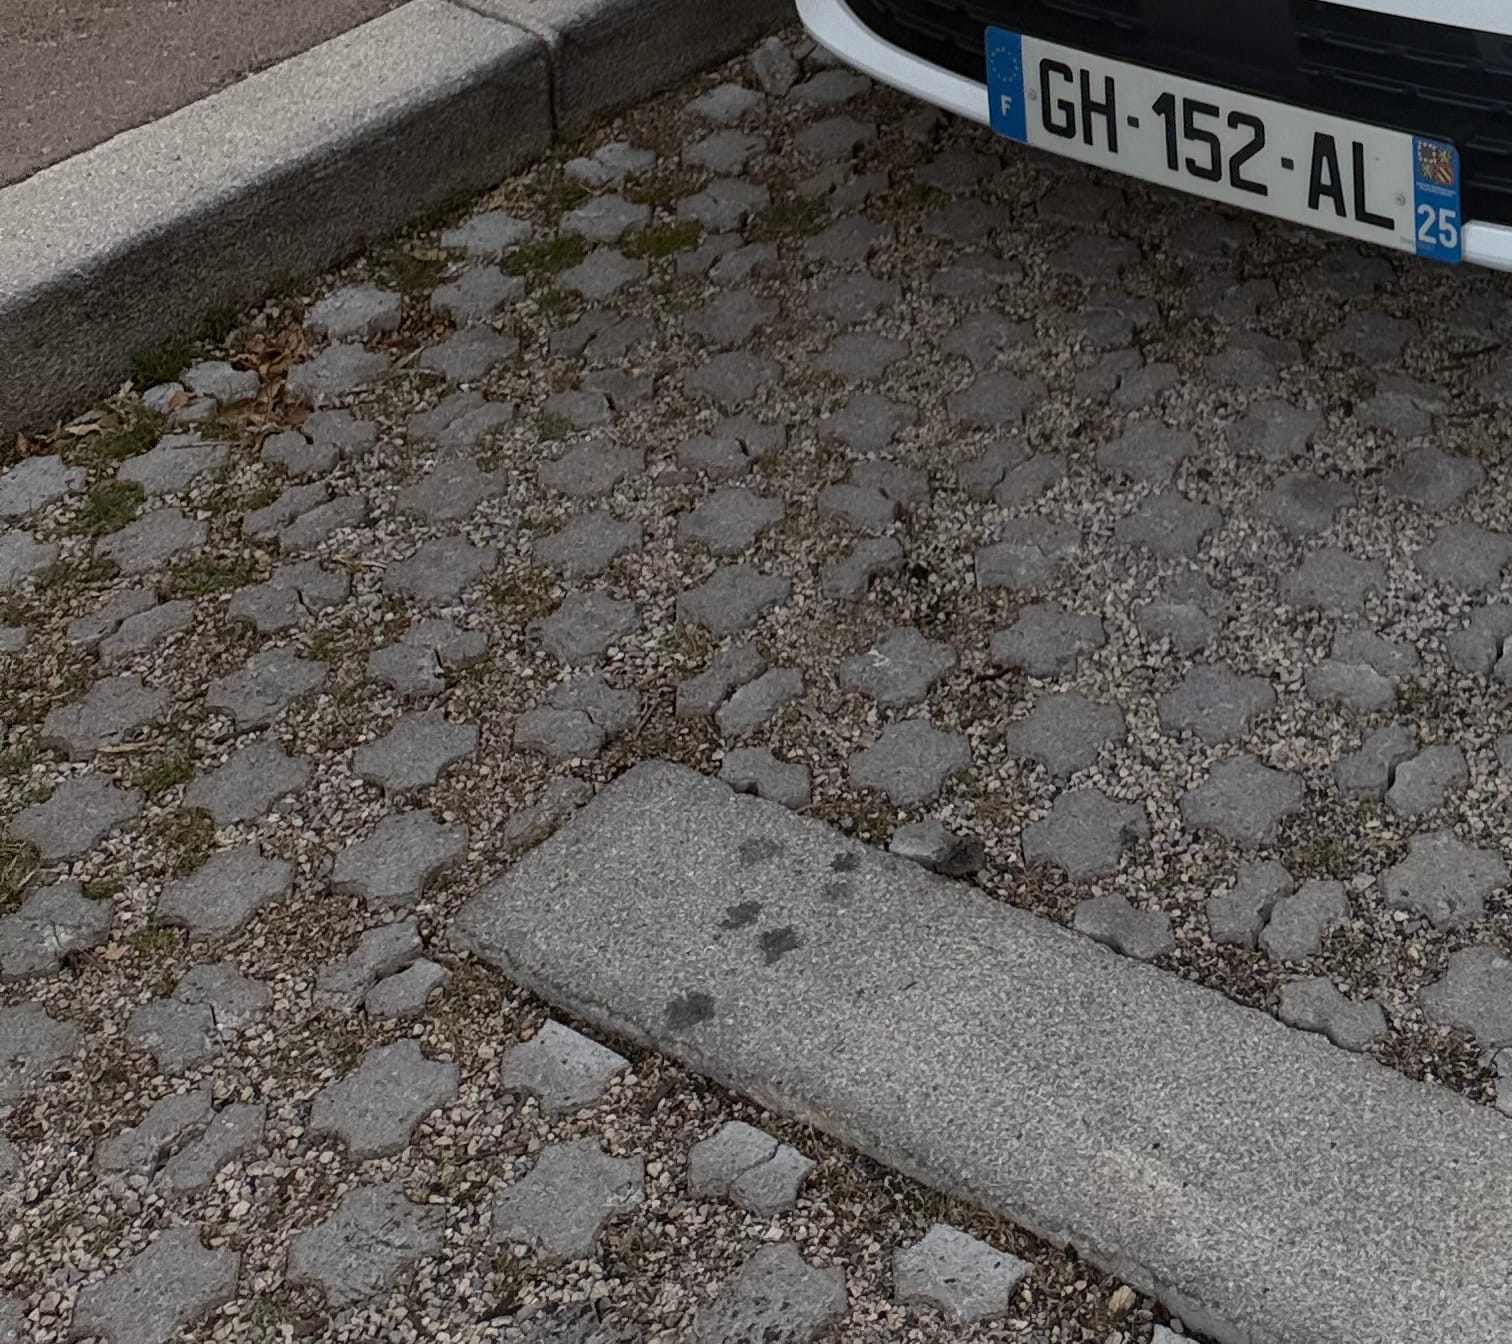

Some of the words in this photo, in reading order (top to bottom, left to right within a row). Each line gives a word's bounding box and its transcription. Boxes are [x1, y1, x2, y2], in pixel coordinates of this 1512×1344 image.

[1000, 94, 1013, 117] F
[1039, 57, 1395, 231] GH-152-AL
[1417, 204, 1457, 249] 25
